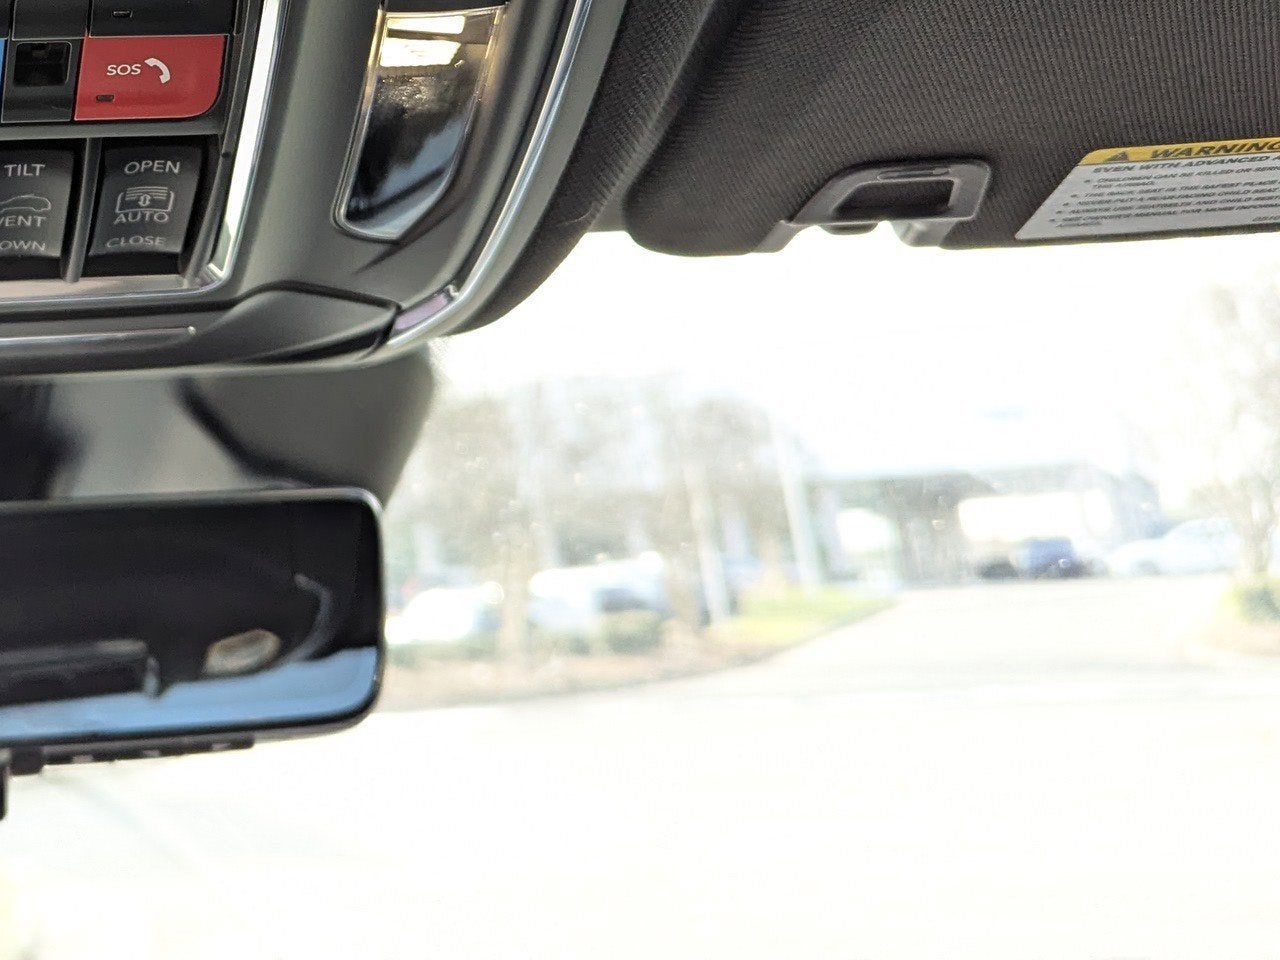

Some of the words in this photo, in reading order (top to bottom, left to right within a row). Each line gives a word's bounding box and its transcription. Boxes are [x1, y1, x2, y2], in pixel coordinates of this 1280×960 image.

[106, 63, 141, 76] SOS
[4, 163, 46, 177] TILT
[124, 160, 181, 174] OPEN
[1093, 165, 1136, 173] EVEN
[1181, 155, 1271, 167] ADVANCED
[113, 211, 169, 225] AUTO
[106, 235, 166, 249] CLOSE
